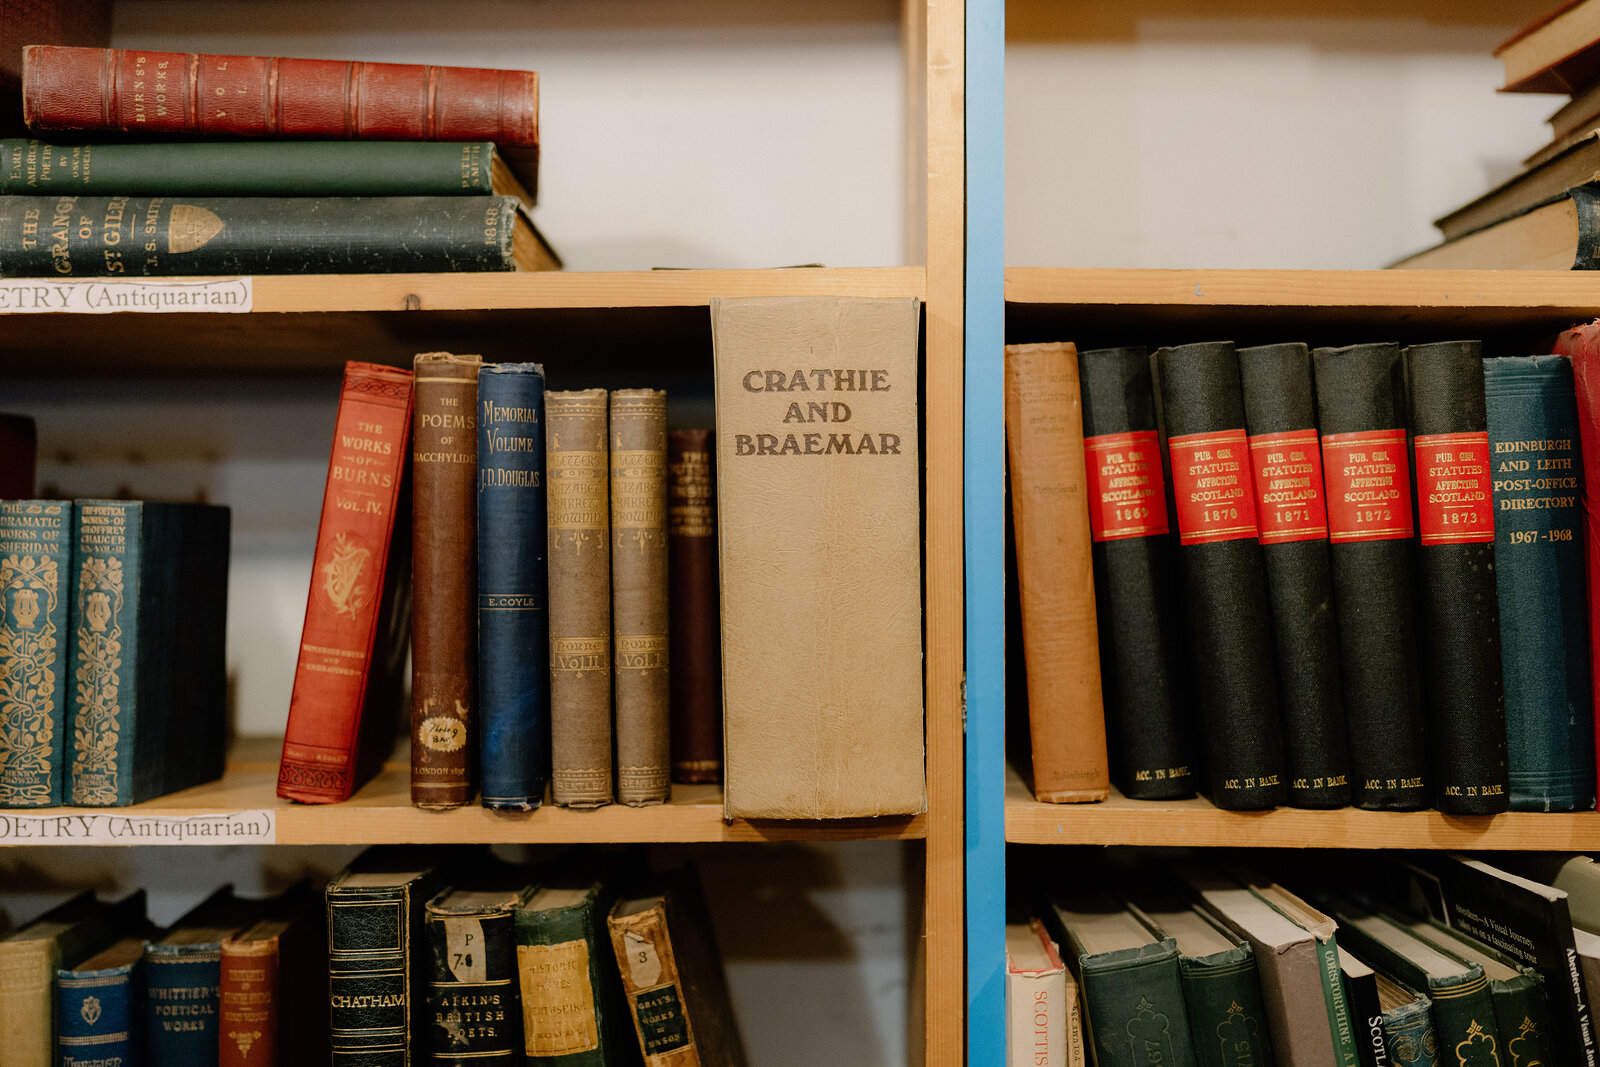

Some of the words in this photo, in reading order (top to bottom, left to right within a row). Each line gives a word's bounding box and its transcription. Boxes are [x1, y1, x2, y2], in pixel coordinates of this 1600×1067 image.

[136, 57, 146, 122] BURNS'S
[10, 146, 22, 179] EARLY
[462, 146, 470, 188] PETER
[471, 146, 480, 187] SMITH
[22, 208, 40, 250] THE
[79, 216, 94, 240] OF
[484, 208, 499, 246] 1898
[145, 235, 158, 250] S.
[86, 283, 248, 311] (Antiquarian)
[742, 368, 892, 394] CRATHIE
[440, 398, 458, 406] THE
[482, 400, 538, 427] MEMORIAL
[782, 401, 852, 424] AND
[358, 422, 384, 434] THE
[422, 414, 476, 429] POEMS
[342, 436, 392, 456] WORKS
[440, 436, 454, 444] OF
[487, 428, 534, 455] VOLUME
[734, 432, 902, 456] BRAEMAR
[1494, 439, 1572, 454] EDINBURGH
[357, 456, 372, 465] OF
[1498, 460, 1530, 472] AND
[1536, 458, 1572, 471] LEITH
[1102, 462, 1150, 476] STATUTES
[1190, 462, 1240, 476] STATUTES
[1262, 464, 1312, 477] STATUTES
[1344, 464, 1396, 476] STATUTES
[1429, 465, 1482, 476] STATUTES
[332, 466, 392, 488] BURNS
[1494, 477, 1578, 492] POST-OFFICE
[1102, 488, 1154, 502] SCOTLAND
[1190, 488, 1244, 502] SCOTLAND
[1263, 490, 1316, 504] SCOTLAND
[1344, 490, 1400, 502] SCOTLAND
[1429, 492, 1486, 504] SCOTLAND
[1500, 496, 1574, 510] DIRECTORY
[1116, 507, 1148, 520] 1869
[1204, 508, 1238, 522] 1870
[1276, 510, 1310, 522] 1871
[1356, 510, 1392, 522] 1872
[1442, 512, 1478, 525] 1873
[0, 516, 60, 528] DRAMATIC
[0, 529, 36, 540] WORKS
[42, 529, 60, 540] OF
[0, 542, 60, 554] SHERIDAN
[414, 766, 448, 776] LONDON
[1136, 769, 1152, 782] ACC.
[1156, 768, 1166, 780] IN
[556, 780, 606, 792] BENTLEY
[1224, 778, 1242, 790] ACC.
[1244, 778, 1256, 788] IN
[1292, 778, 1310, 790] ACC.
[1313, 777, 1324, 788] IN
[1365, 778, 1383, 790] ACC.
[1386, 778, 1398, 790] IN
[1446, 786, 1464, 797] ACC.
[1466, 786, 1478, 796] IN
[108, 812, 272, 841] (Antiquarian)
[465, 934, 474, 946] P
[332, 994, 405, 1008] CHATHAM
[441, 994, 500, 1006] AIKIN'S
[1324, 950, 1351, 1046] CORSTORPHINE
[156, 1004, 214, 1017] POETICAL
[447, 1027, 498, 1038] OETS.
[1072, 1025, 1081, 1062] VOLUME
[1580, 1014, 1592, 1046] Visual
[1586, 1048, 1596, 1067] Jou
